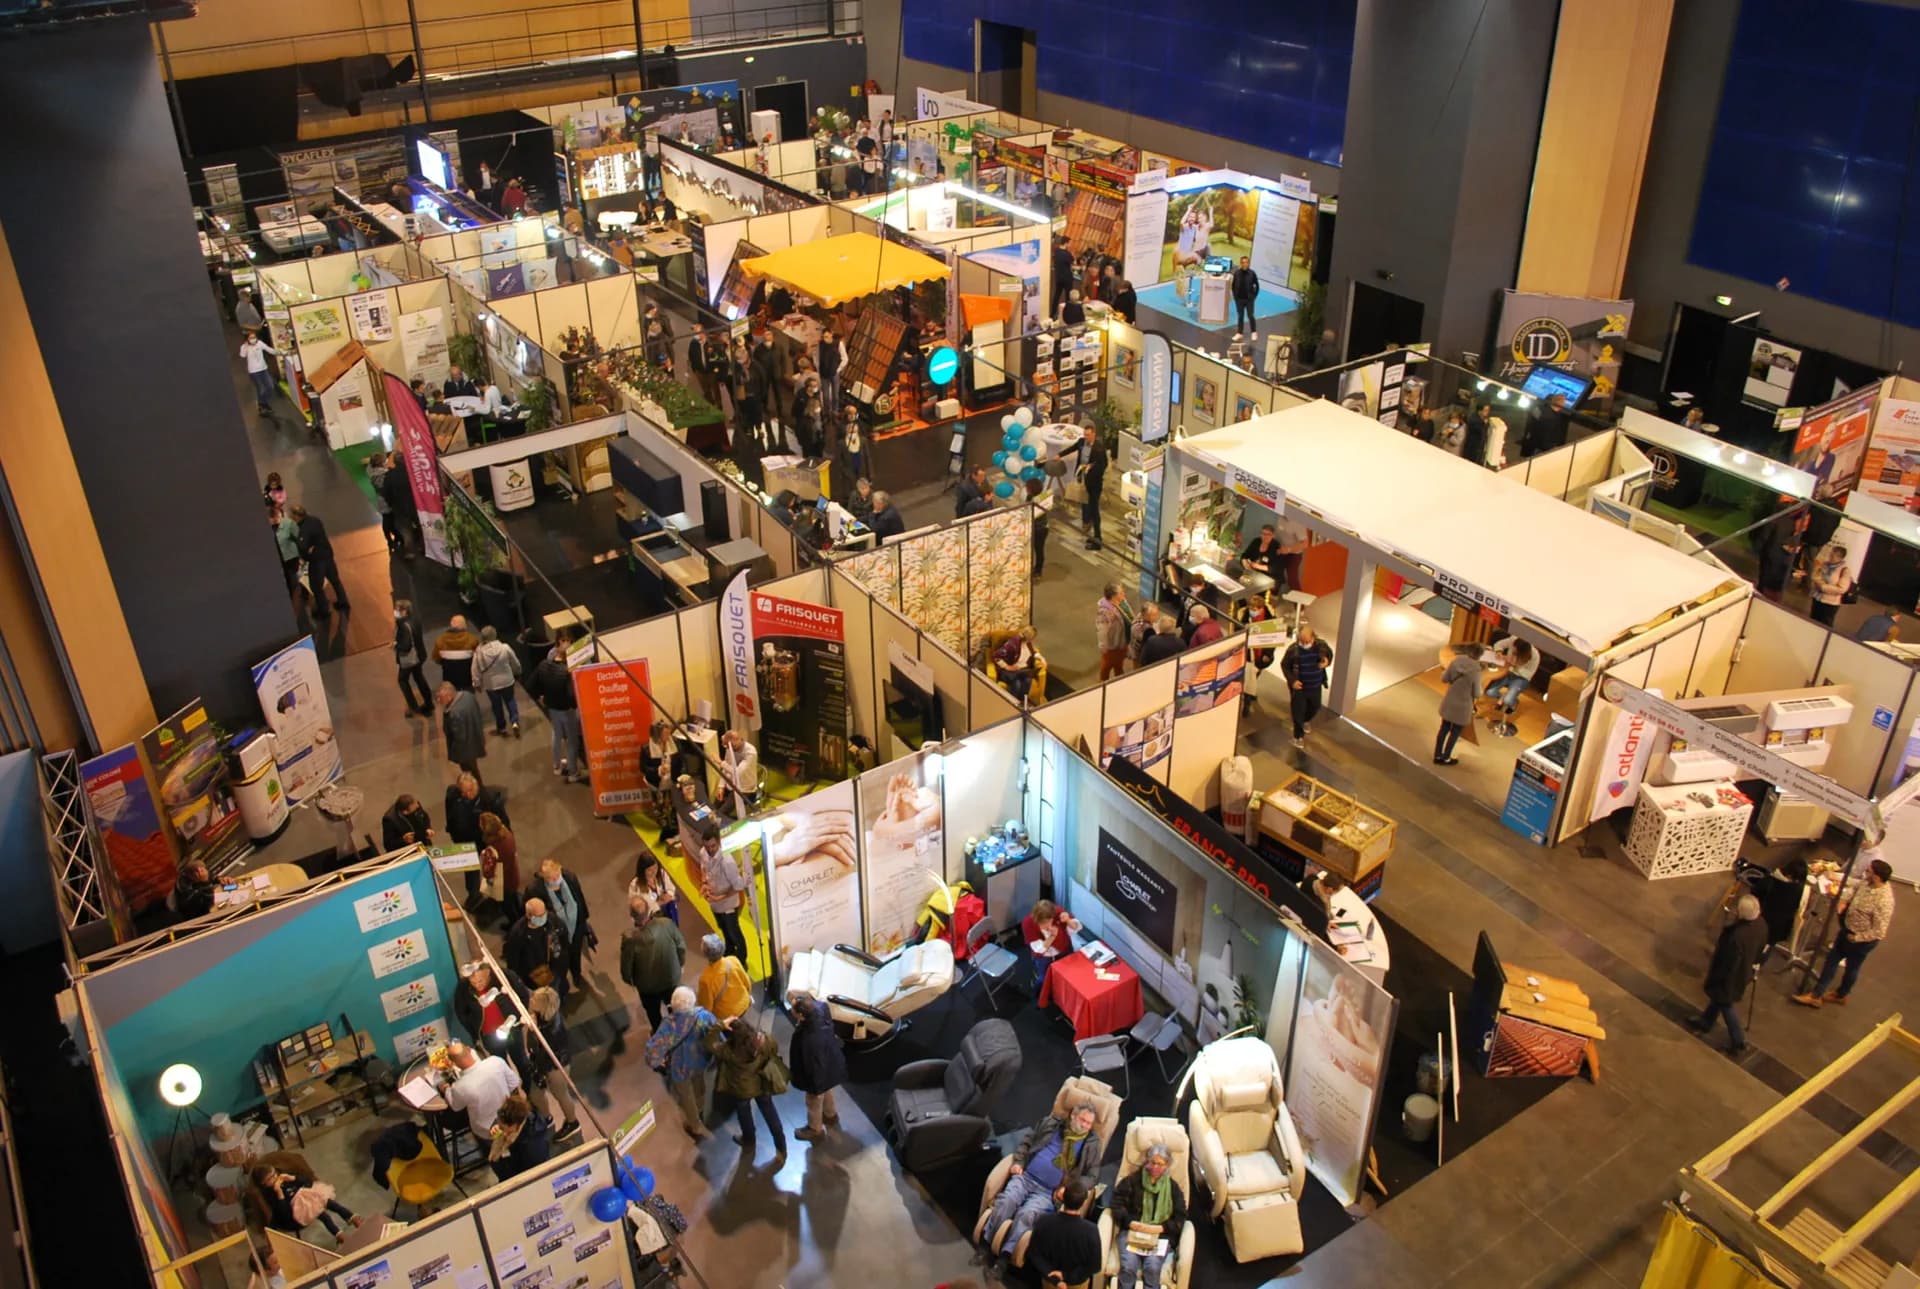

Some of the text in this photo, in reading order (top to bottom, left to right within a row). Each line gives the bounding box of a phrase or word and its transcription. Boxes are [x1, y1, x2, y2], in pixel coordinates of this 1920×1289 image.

[776, 603, 837, 625] FRISQUET
[729, 592, 748, 688] FRISQUET
[1618, 715, 1645, 777] atlanti
[1714, 731, 1766, 761] Climatisation
[790, 866, 834, 890] CHARLET
[1173, 816, 1270, 900] FRANCE PRO
